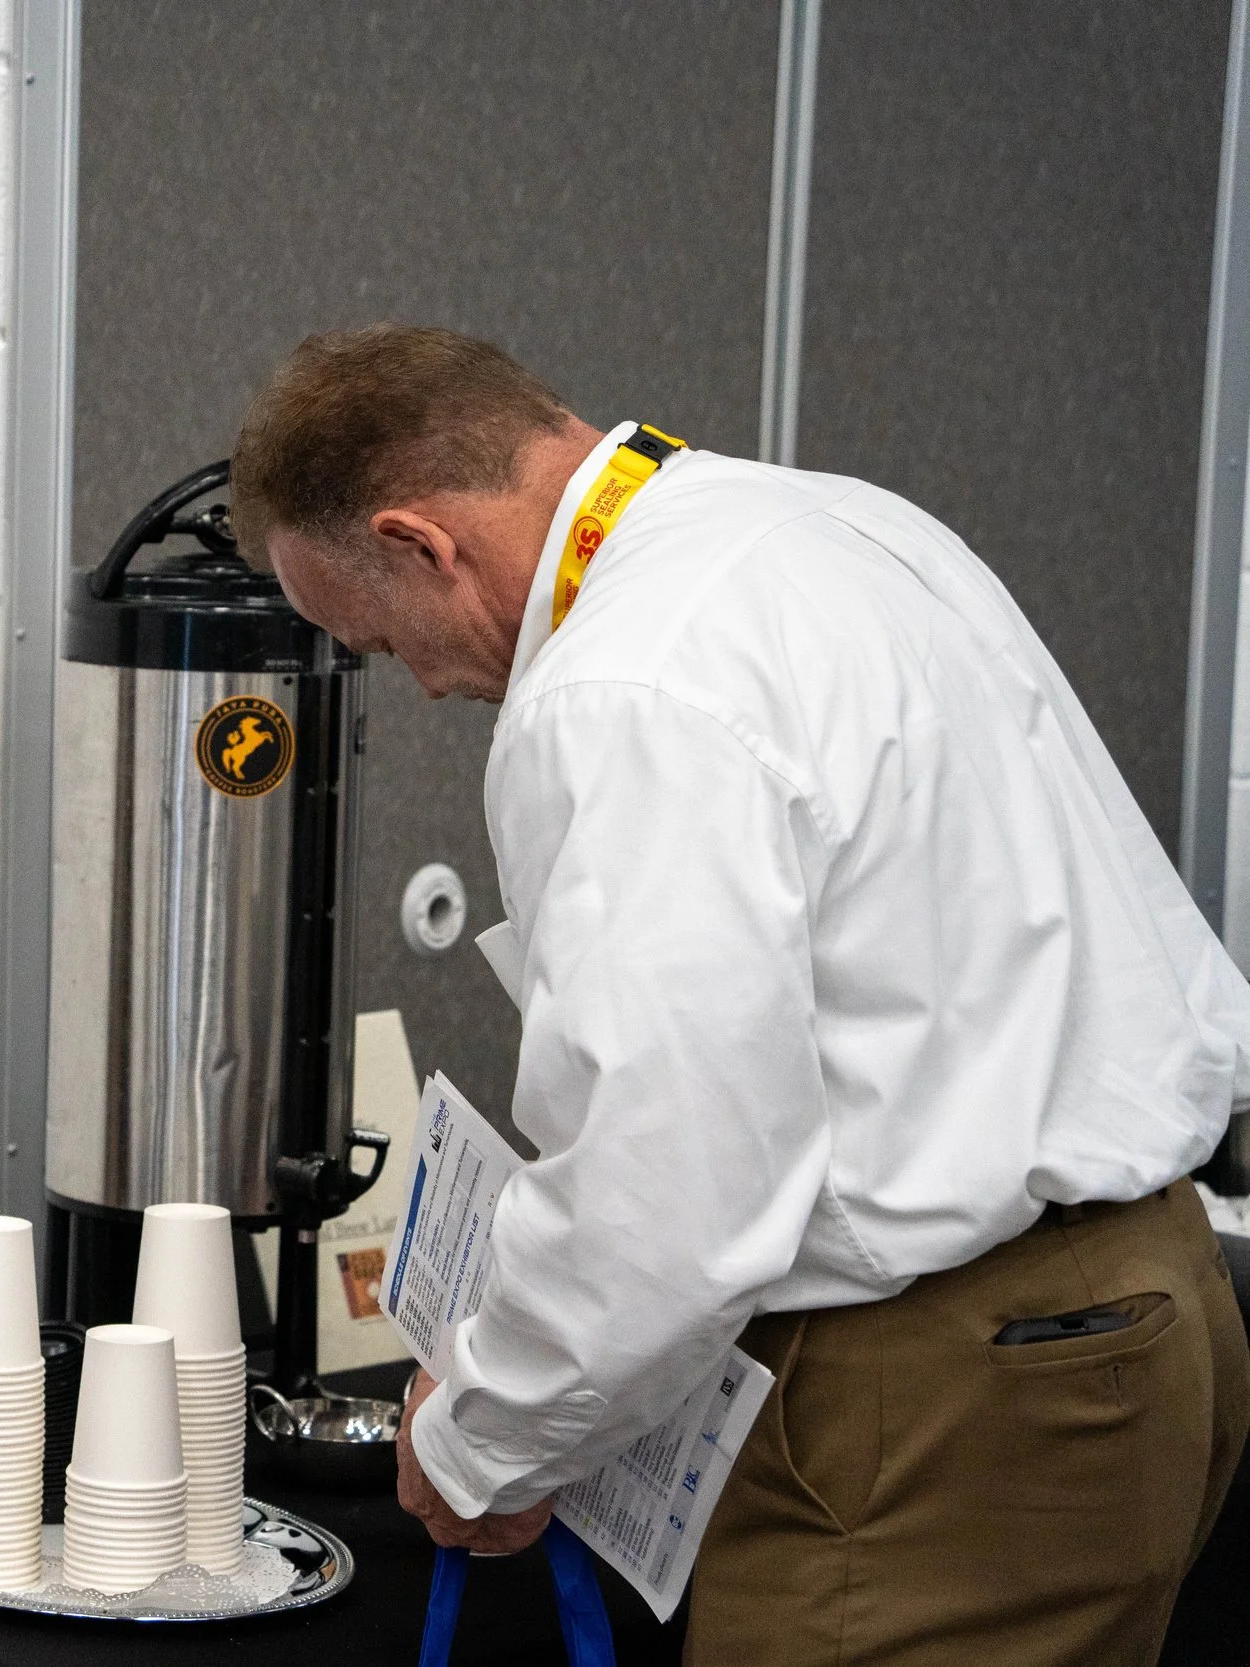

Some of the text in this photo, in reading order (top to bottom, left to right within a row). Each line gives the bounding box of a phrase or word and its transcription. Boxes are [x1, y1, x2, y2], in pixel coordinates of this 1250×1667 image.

[590, 477, 618, 514] SUPERIOR
[597, 485, 622, 516] SEALING
[604, 484, 632, 517] SERVICES
[433, 1098, 447, 1131] PRIME
[438, 1109, 450, 1136] EXPO
[447, 1298, 456, 1324] PRIME
[453, 1275, 462, 1299] EXPO
[459, 1232, 474, 1275] EXHIBITOR
[471, 1213, 479, 1232] LIST
